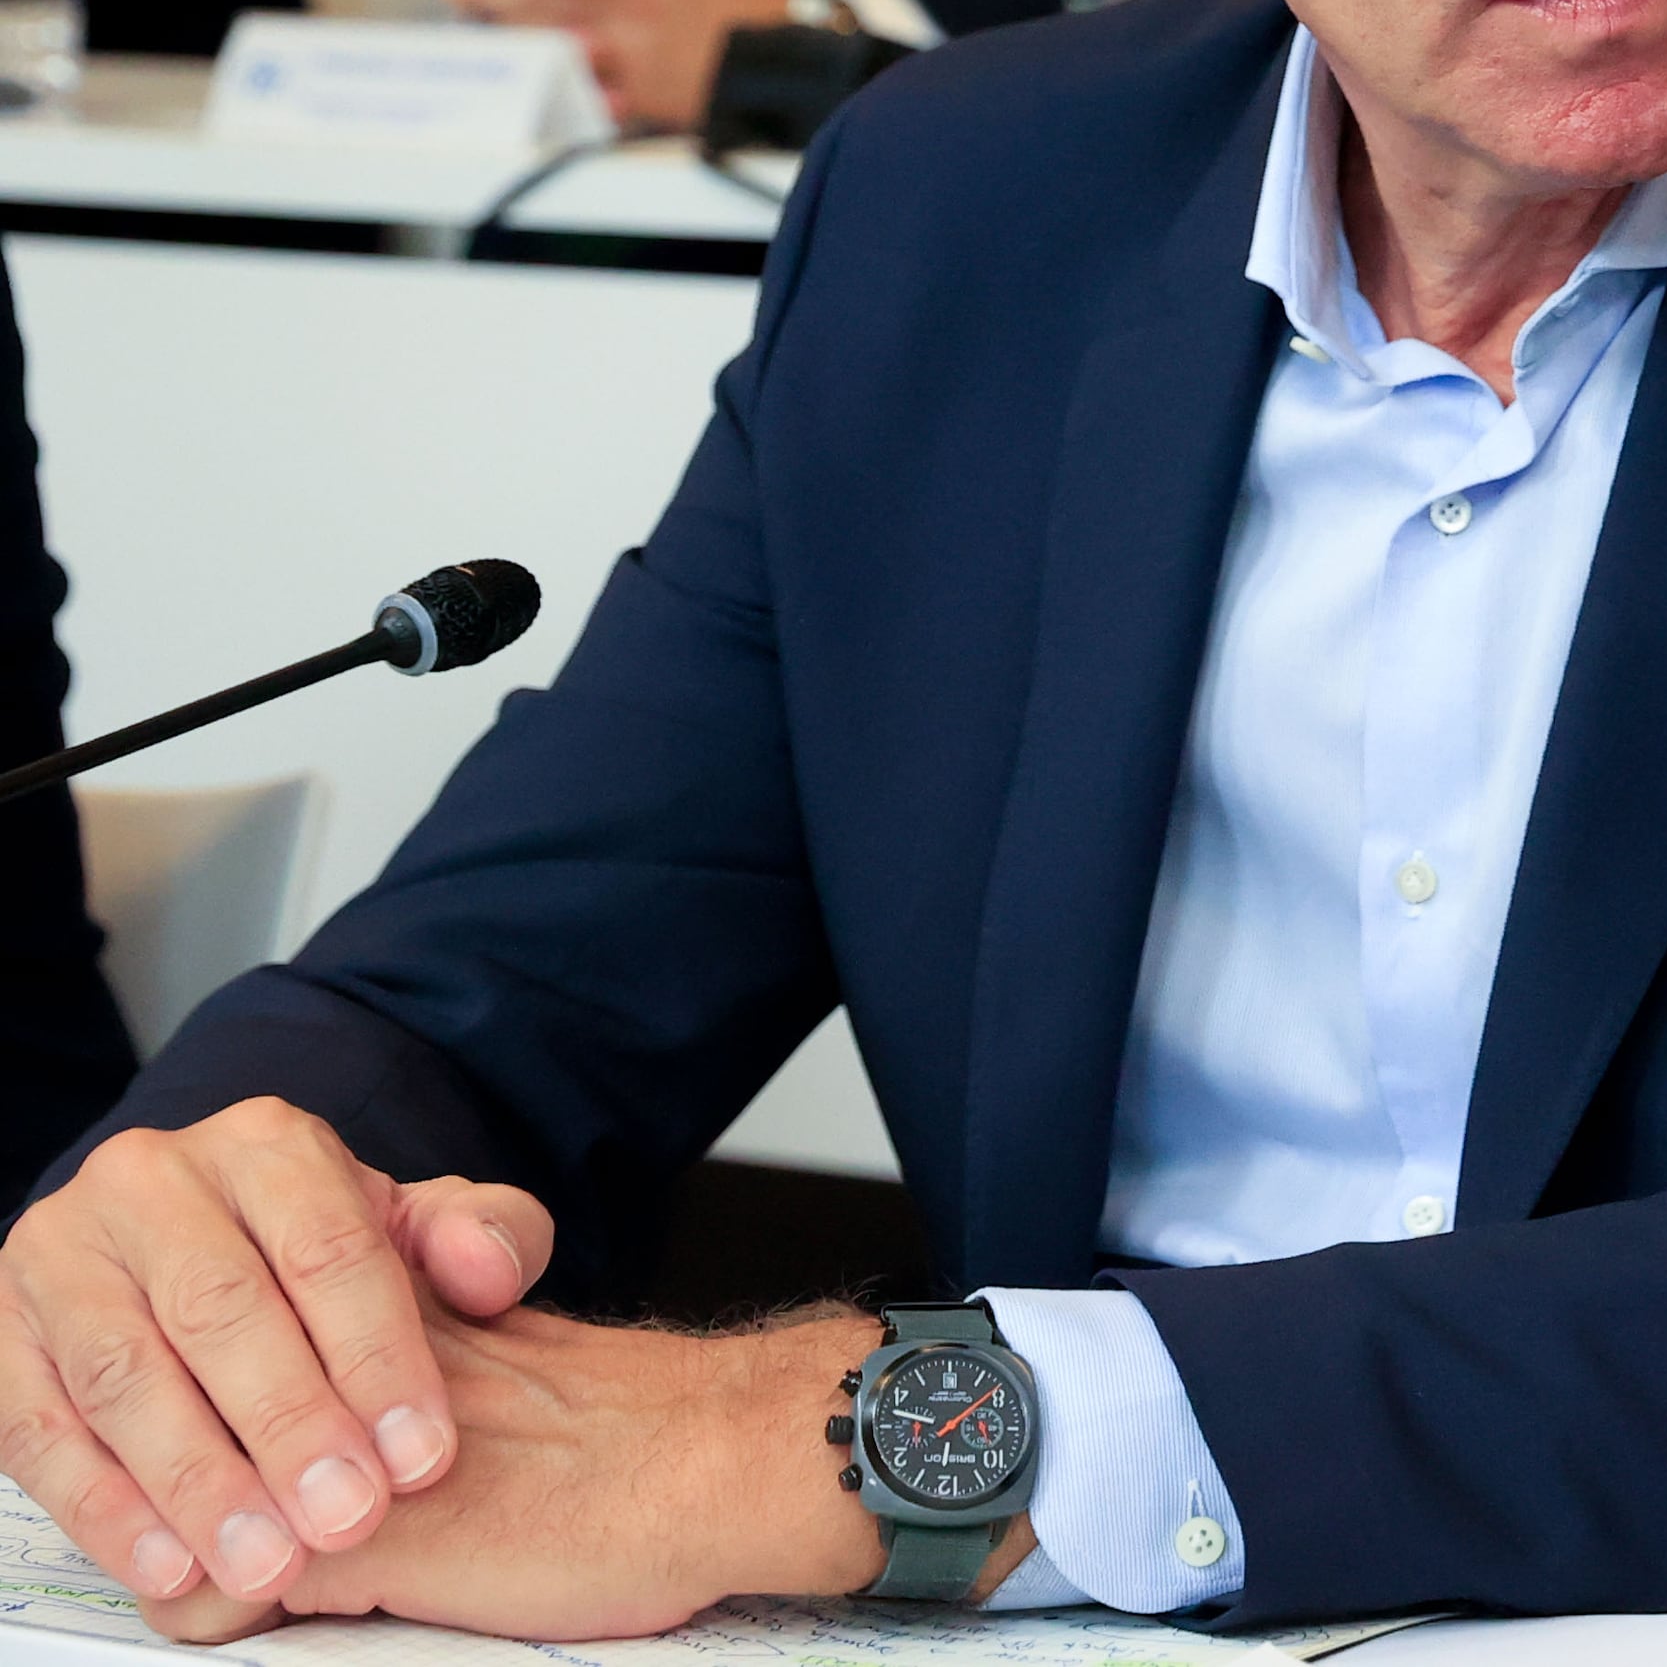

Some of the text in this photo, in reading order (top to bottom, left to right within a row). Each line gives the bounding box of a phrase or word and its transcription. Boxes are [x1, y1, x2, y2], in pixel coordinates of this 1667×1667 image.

[894, 1387, 909, 1406] 4
[992, 1388, 1005, 1408] 8
[893, 1447, 907, 1467] 2
[983, 1449, 1004, 1469] 10
[937, 1475, 958, 1497] 12
